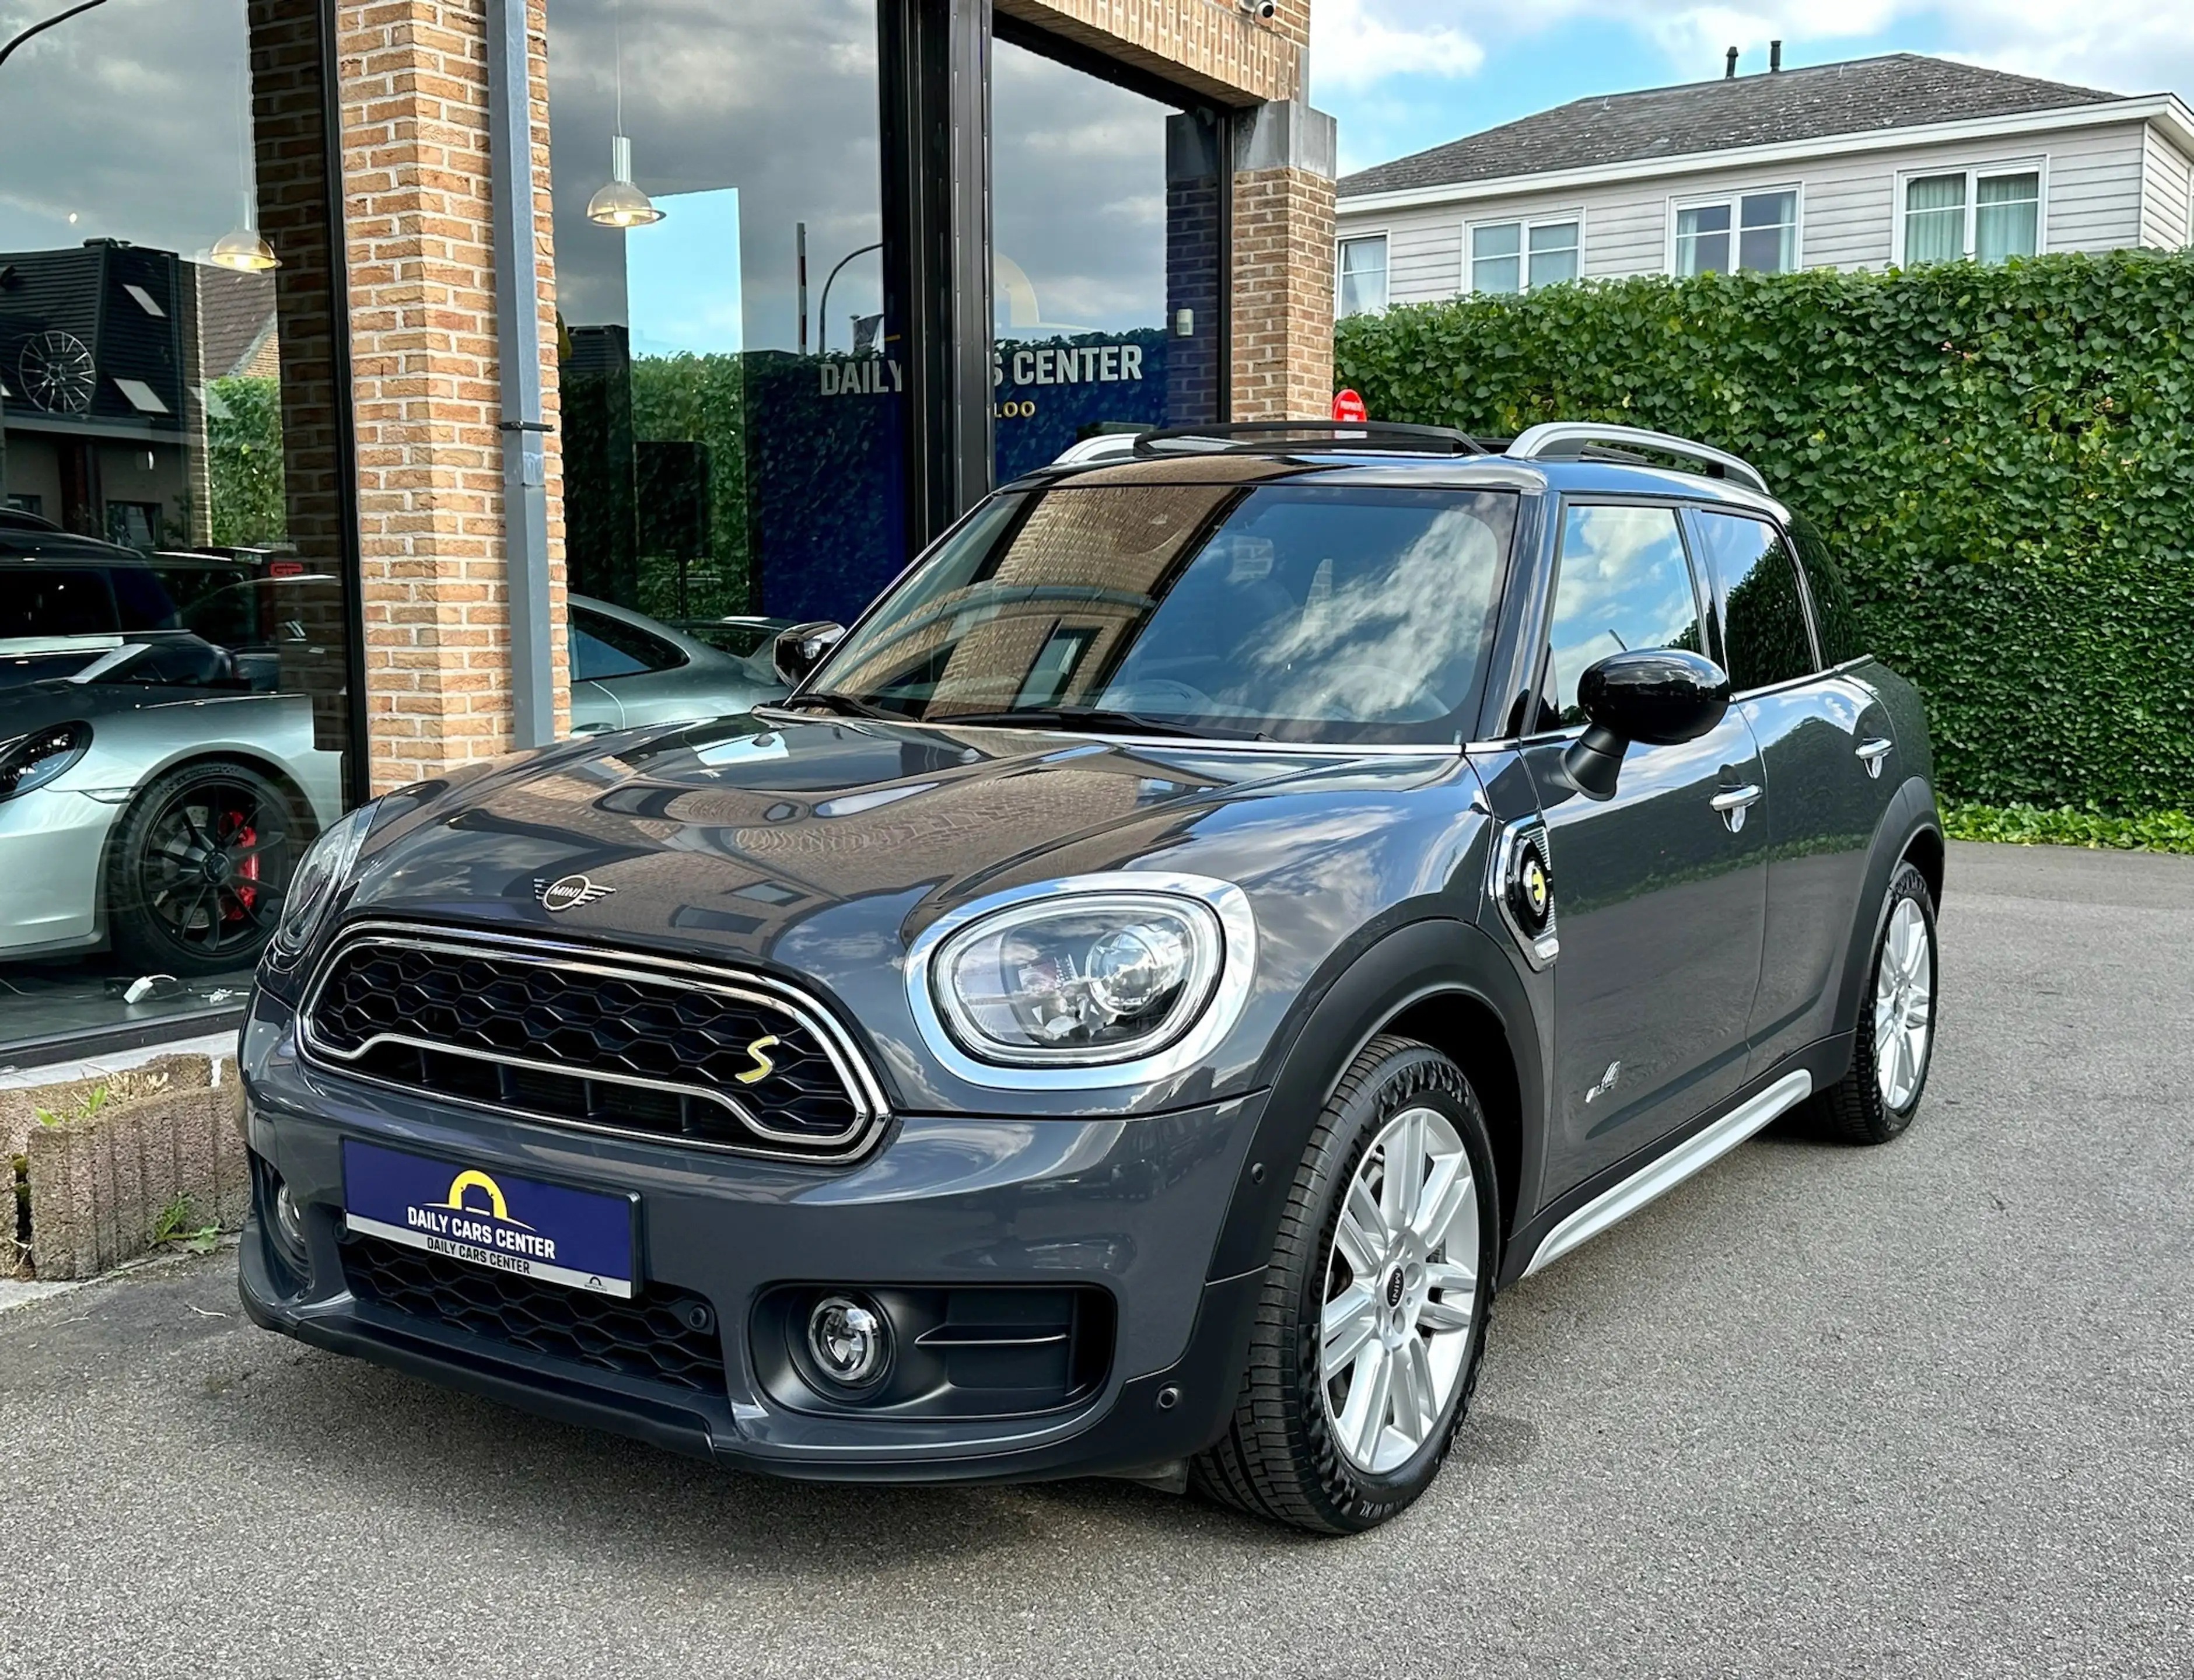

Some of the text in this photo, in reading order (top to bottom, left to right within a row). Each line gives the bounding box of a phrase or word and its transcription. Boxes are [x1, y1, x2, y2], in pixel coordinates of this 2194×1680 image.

[820, 359, 902, 396] DAILY
[1013, 345, 1143, 386] CENTER
[550, 886, 583, 898] MINI
[735, 1035, 779, 1084] S
[408, 1206, 556, 1260] DAILY CARS CENTER
[427, 1237, 530, 1275] DAILY CARS CENTER
[1391, 1272, 1401, 1303] MINI
